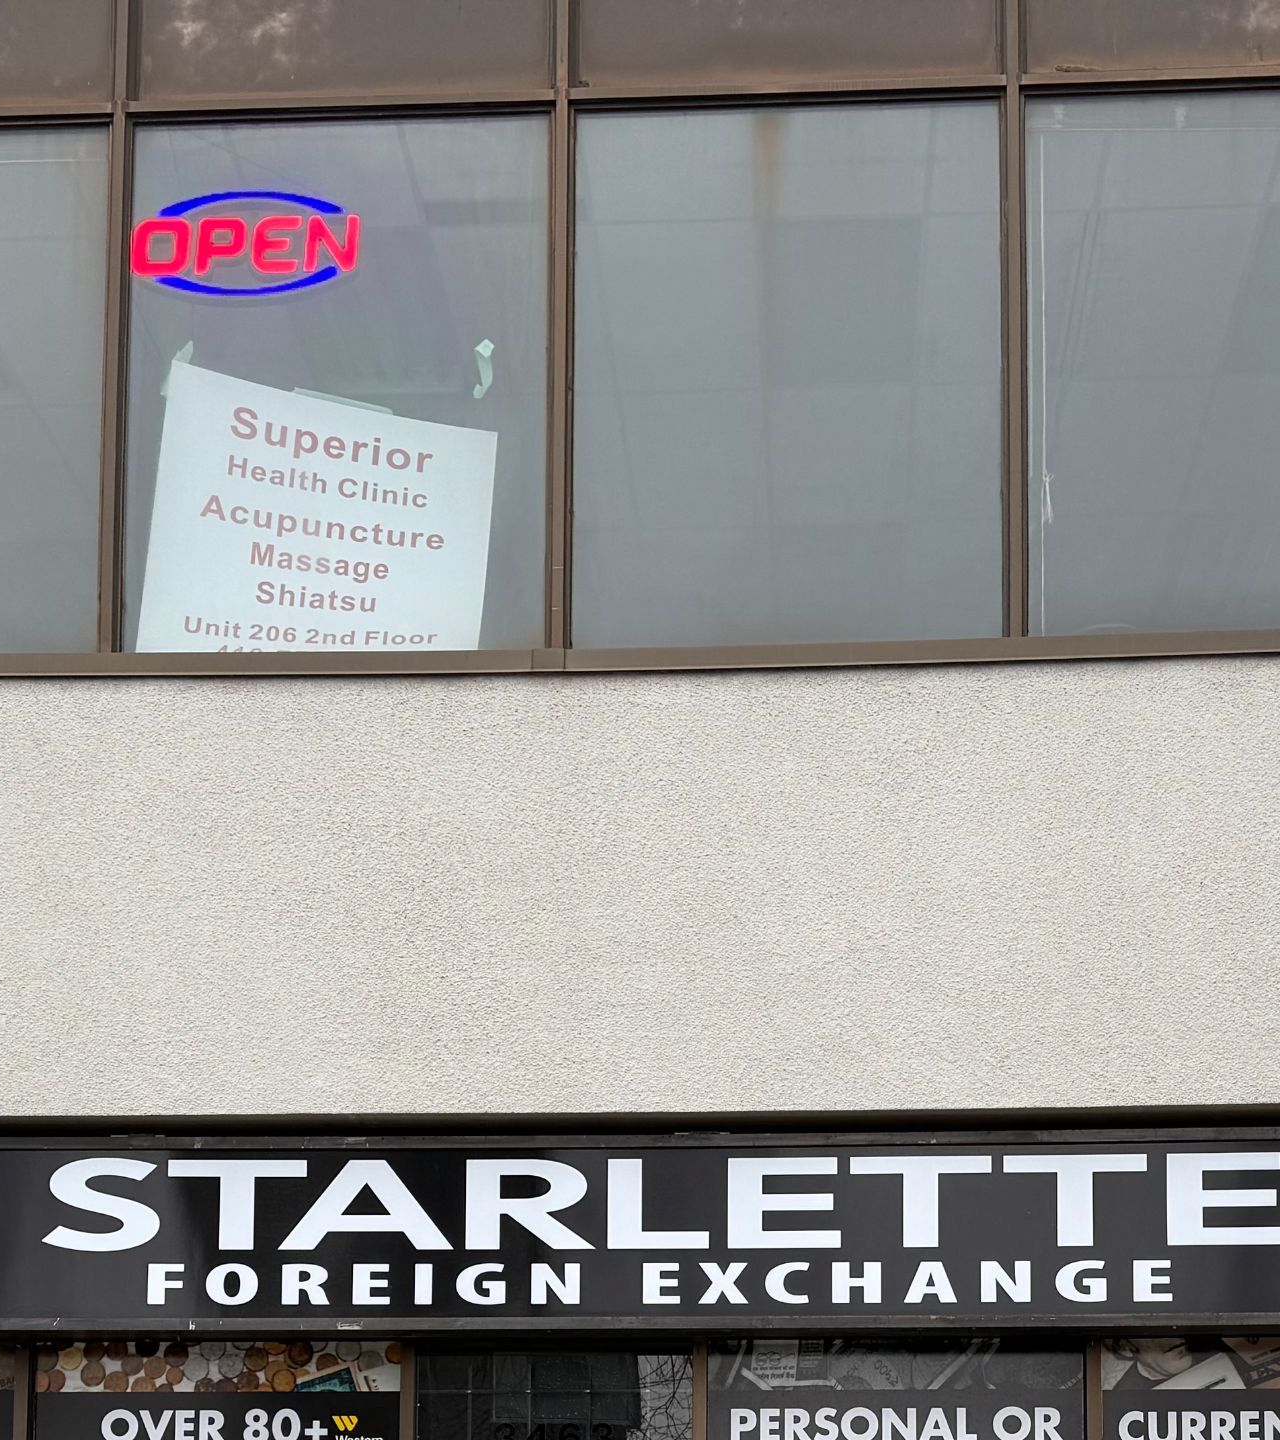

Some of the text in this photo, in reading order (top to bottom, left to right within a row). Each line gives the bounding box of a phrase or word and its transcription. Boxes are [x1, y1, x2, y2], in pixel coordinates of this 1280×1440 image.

[131, 214, 361, 276] OPEN
[229, 406, 434, 473] Superior
[226, 454, 429, 509] Health Clinic
[200, 494, 446, 551] Acupuncture
[249, 541, 390, 584] Massage
[255, 581, 377, 613] Shiatsu
[183, 616, 438, 646] Unit 206 2nd Floor
[146, 1259, 1174, 1307] FOREIGN EXCHANGE
